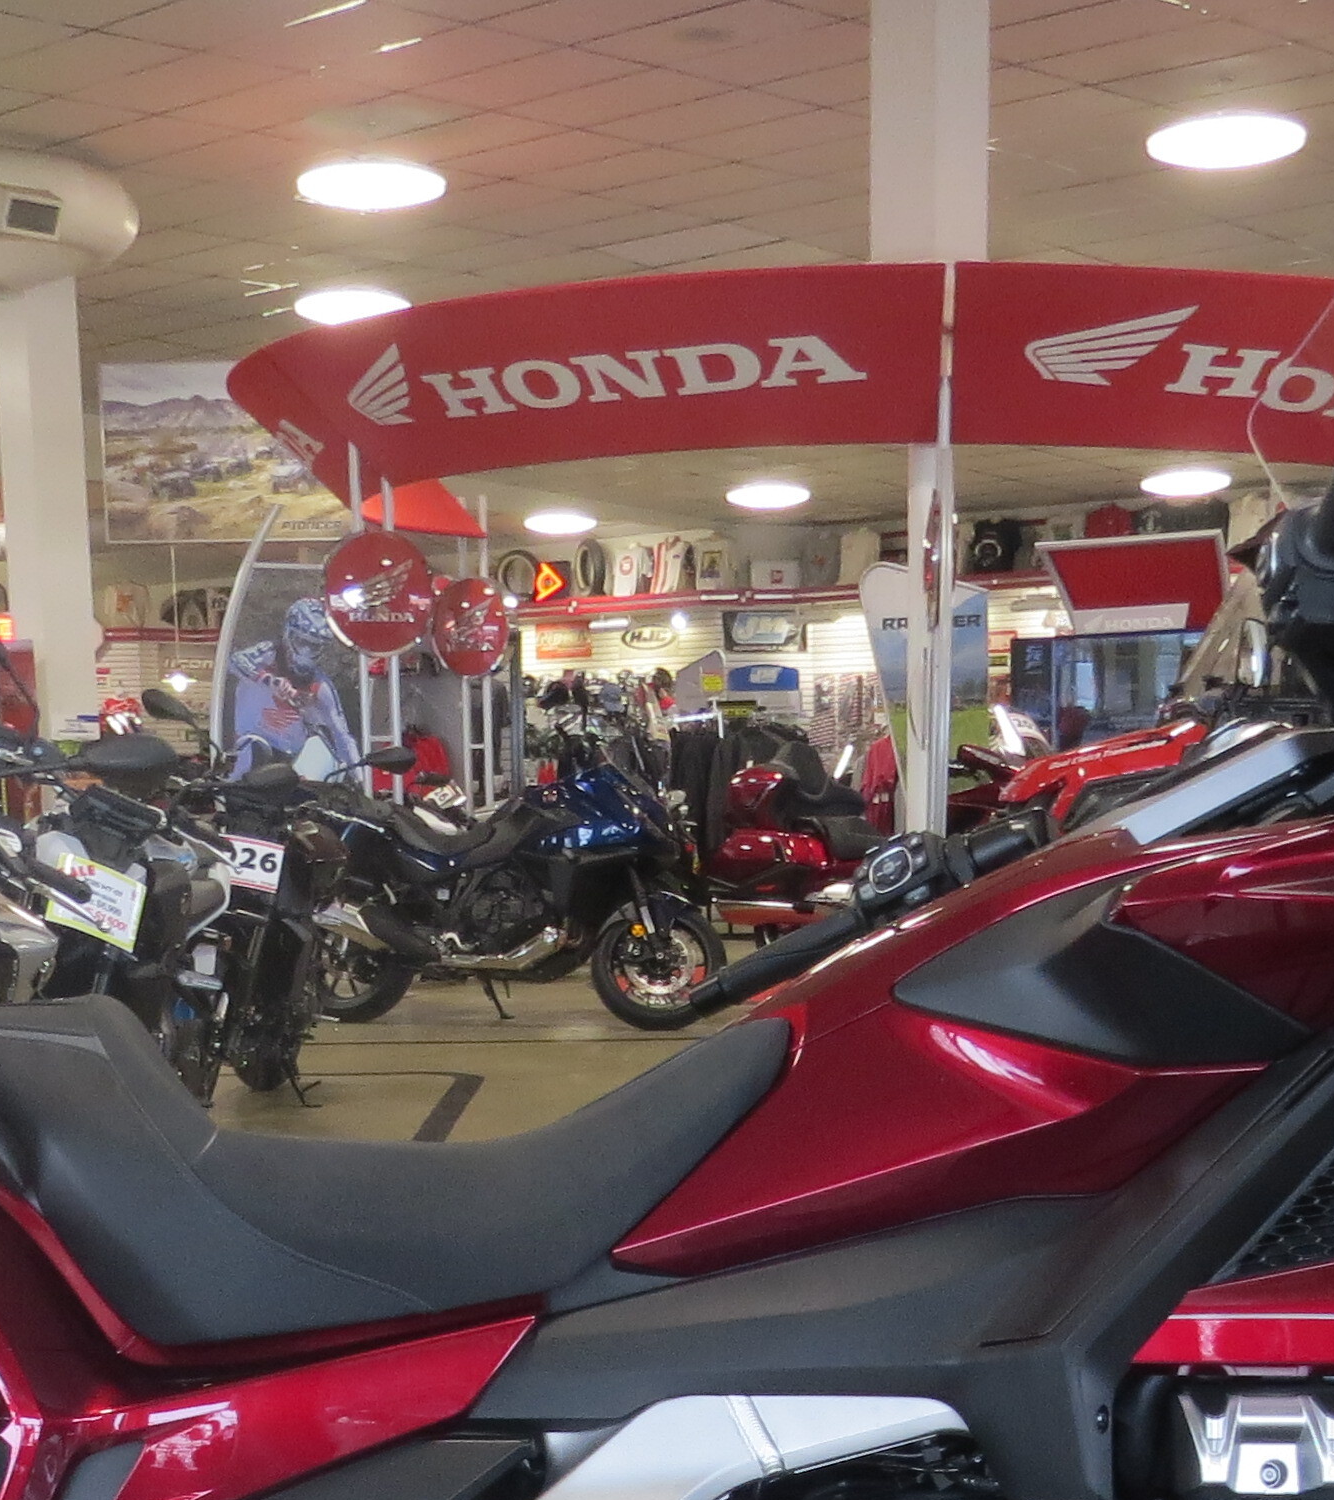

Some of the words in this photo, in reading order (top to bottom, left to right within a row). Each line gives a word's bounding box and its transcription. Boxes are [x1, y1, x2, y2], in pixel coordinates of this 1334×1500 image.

[420, 335, 868, 419] HONDA
[349, 611, 415, 623] HONDA
[882, 614, 981, 631] RAER
[1104, 617, 1174, 630] HONDA
[229, 848, 278, 874] 26
